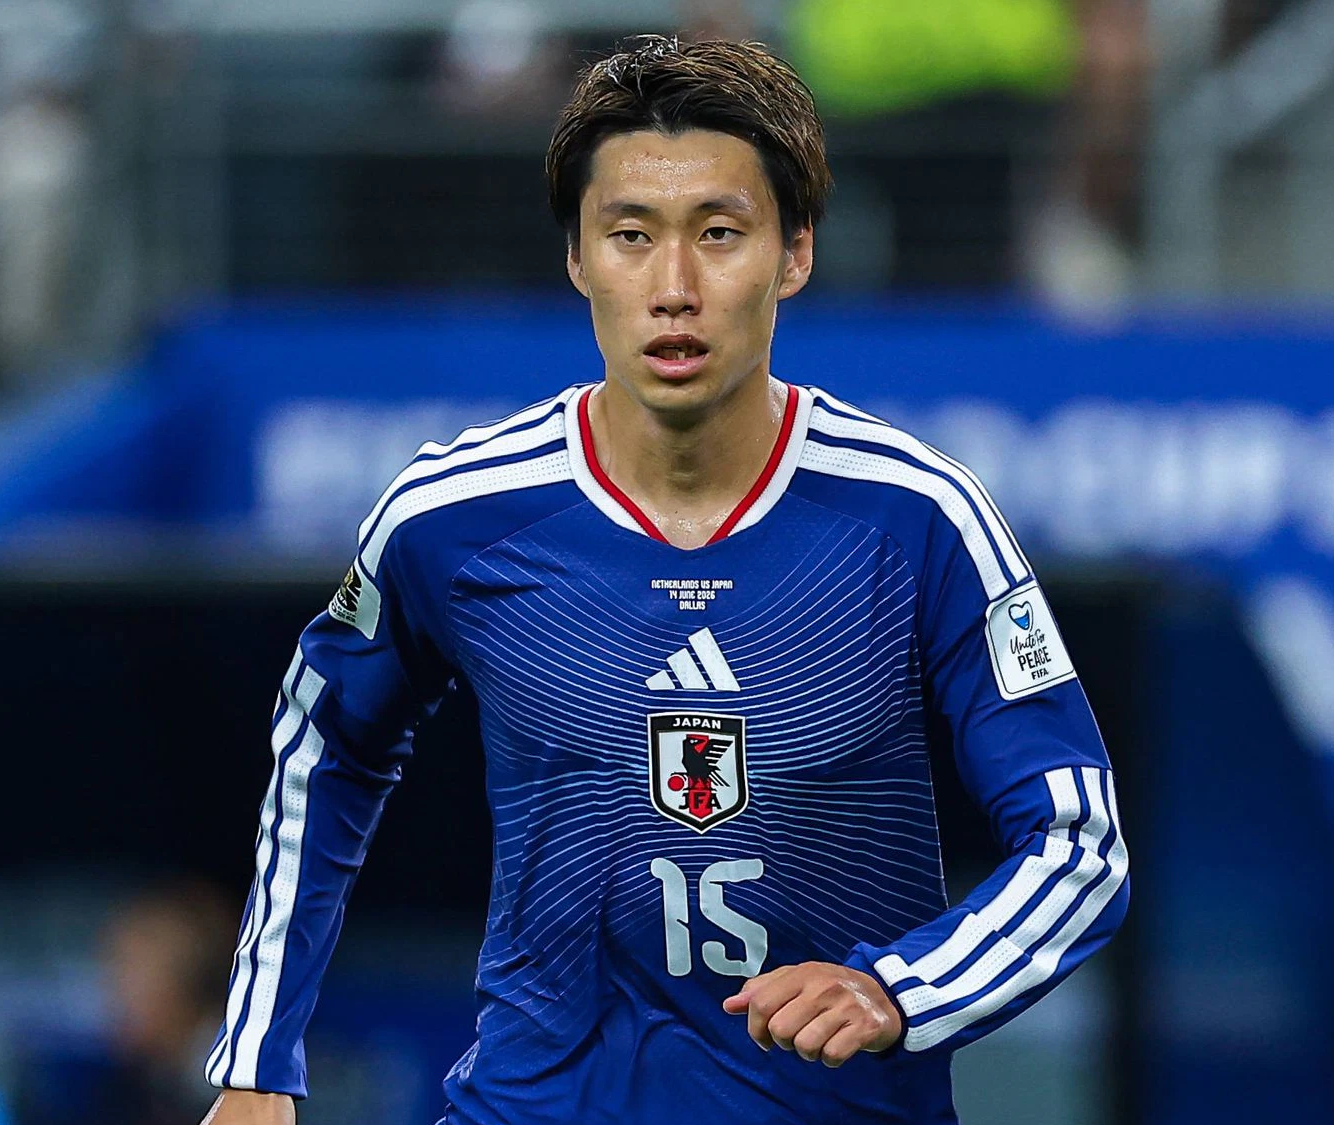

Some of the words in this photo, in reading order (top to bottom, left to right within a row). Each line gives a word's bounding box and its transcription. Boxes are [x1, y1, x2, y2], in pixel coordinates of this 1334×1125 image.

[651, 579, 699, 589] NETHERLANDS
[711, 579, 733, 589] JAPAN
[669, 590, 677, 599] 14
[679, 590, 695, 599] JUNE
[697, 590, 715, 599] 2026
[679, 600, 706, 610] DALLAS
[1017, 646, 1052, 671] PEACE
[1031, 668, 1049, 680] FIFA
[672, 717, 722, 730] JAPAN
[678, 792, 722, 810] JFA
[650, 858, 768, 978] 15
